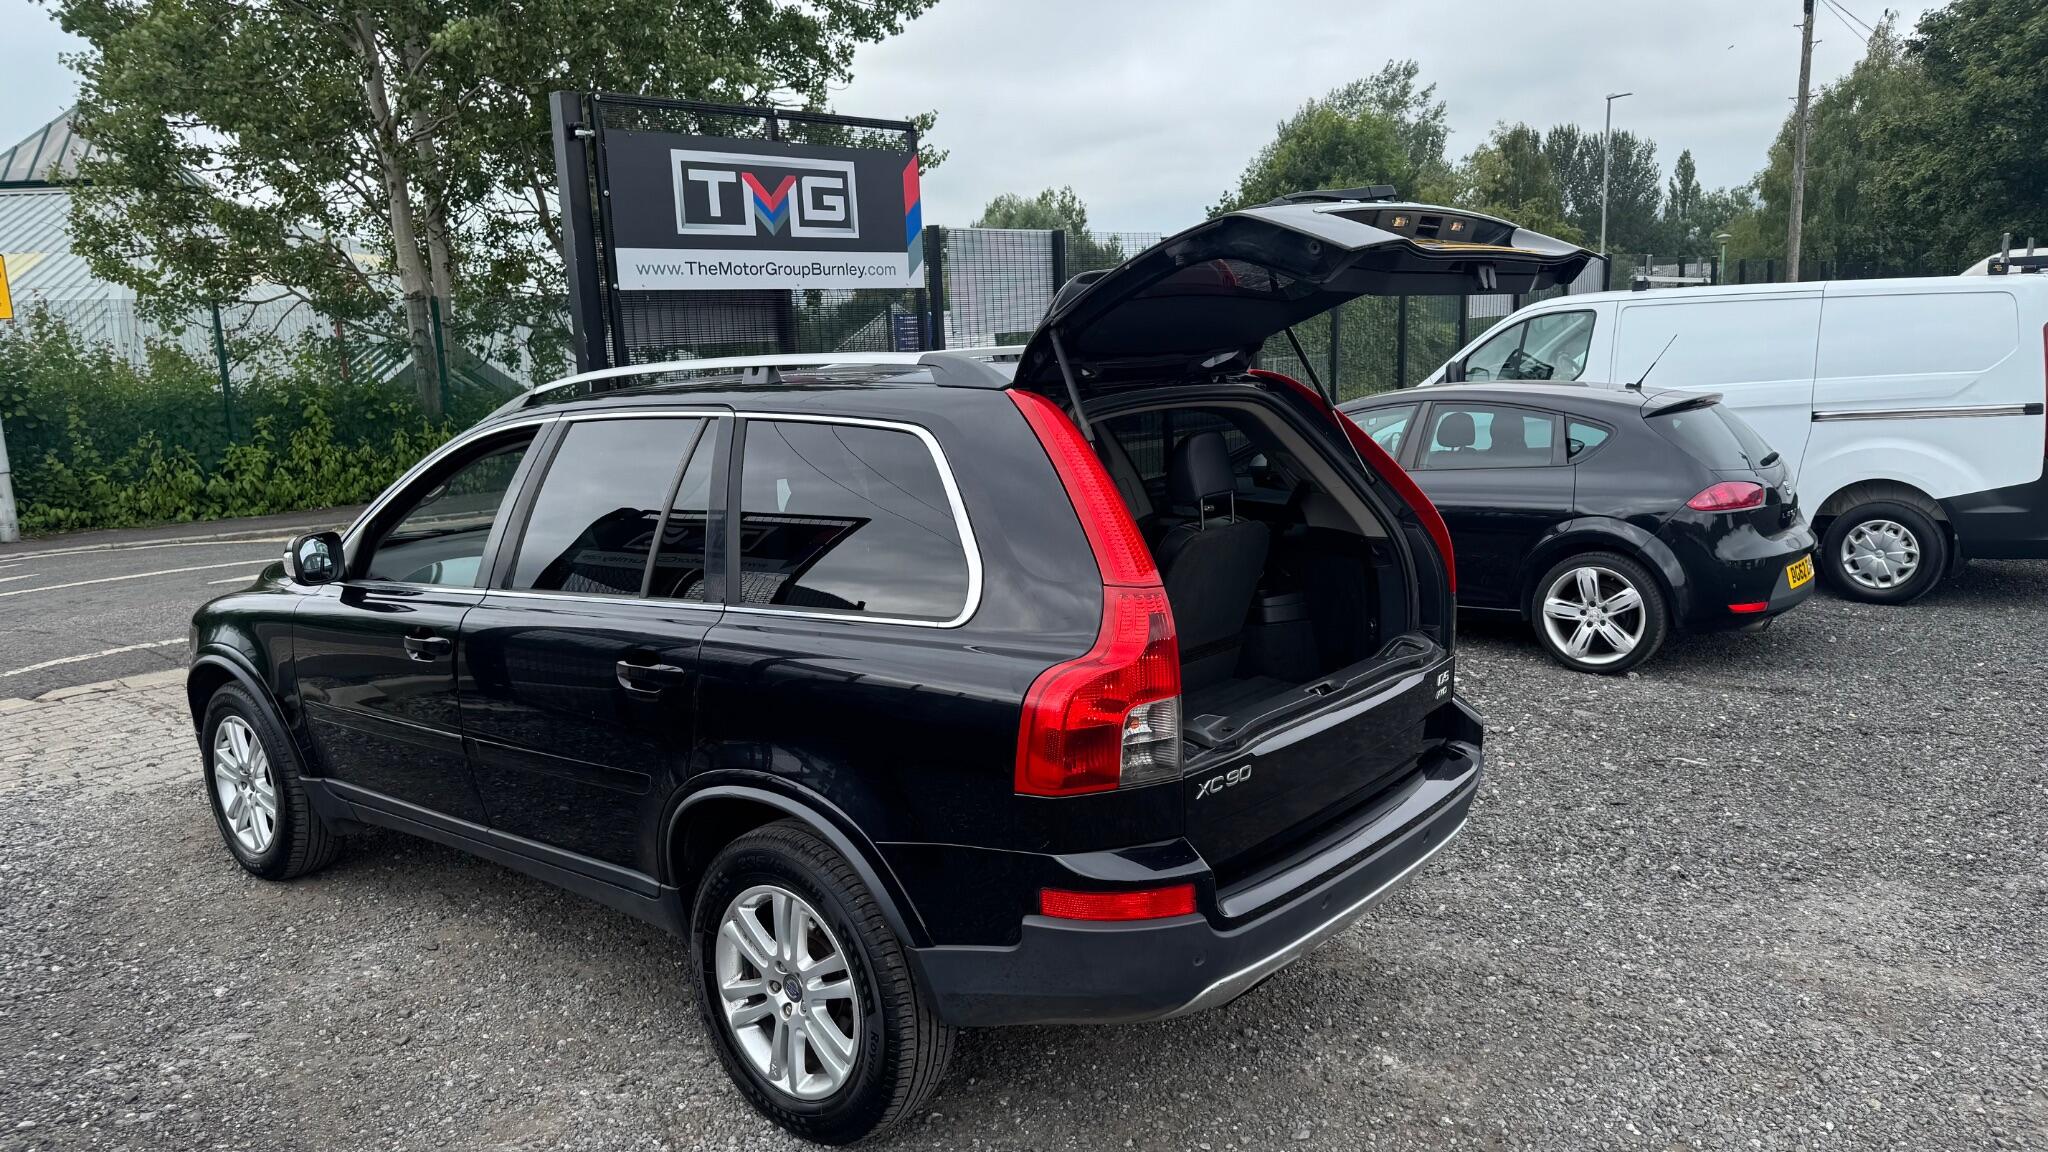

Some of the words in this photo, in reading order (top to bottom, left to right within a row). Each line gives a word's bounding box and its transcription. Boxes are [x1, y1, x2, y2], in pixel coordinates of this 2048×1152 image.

[688, 168, 846, 237] TMG
[636, 261, 896, 279] www.TheMotorGroupBurnley.com
[1437, 670, 1449, 686] D5
[1196, 764, 1252, 800] XC90
